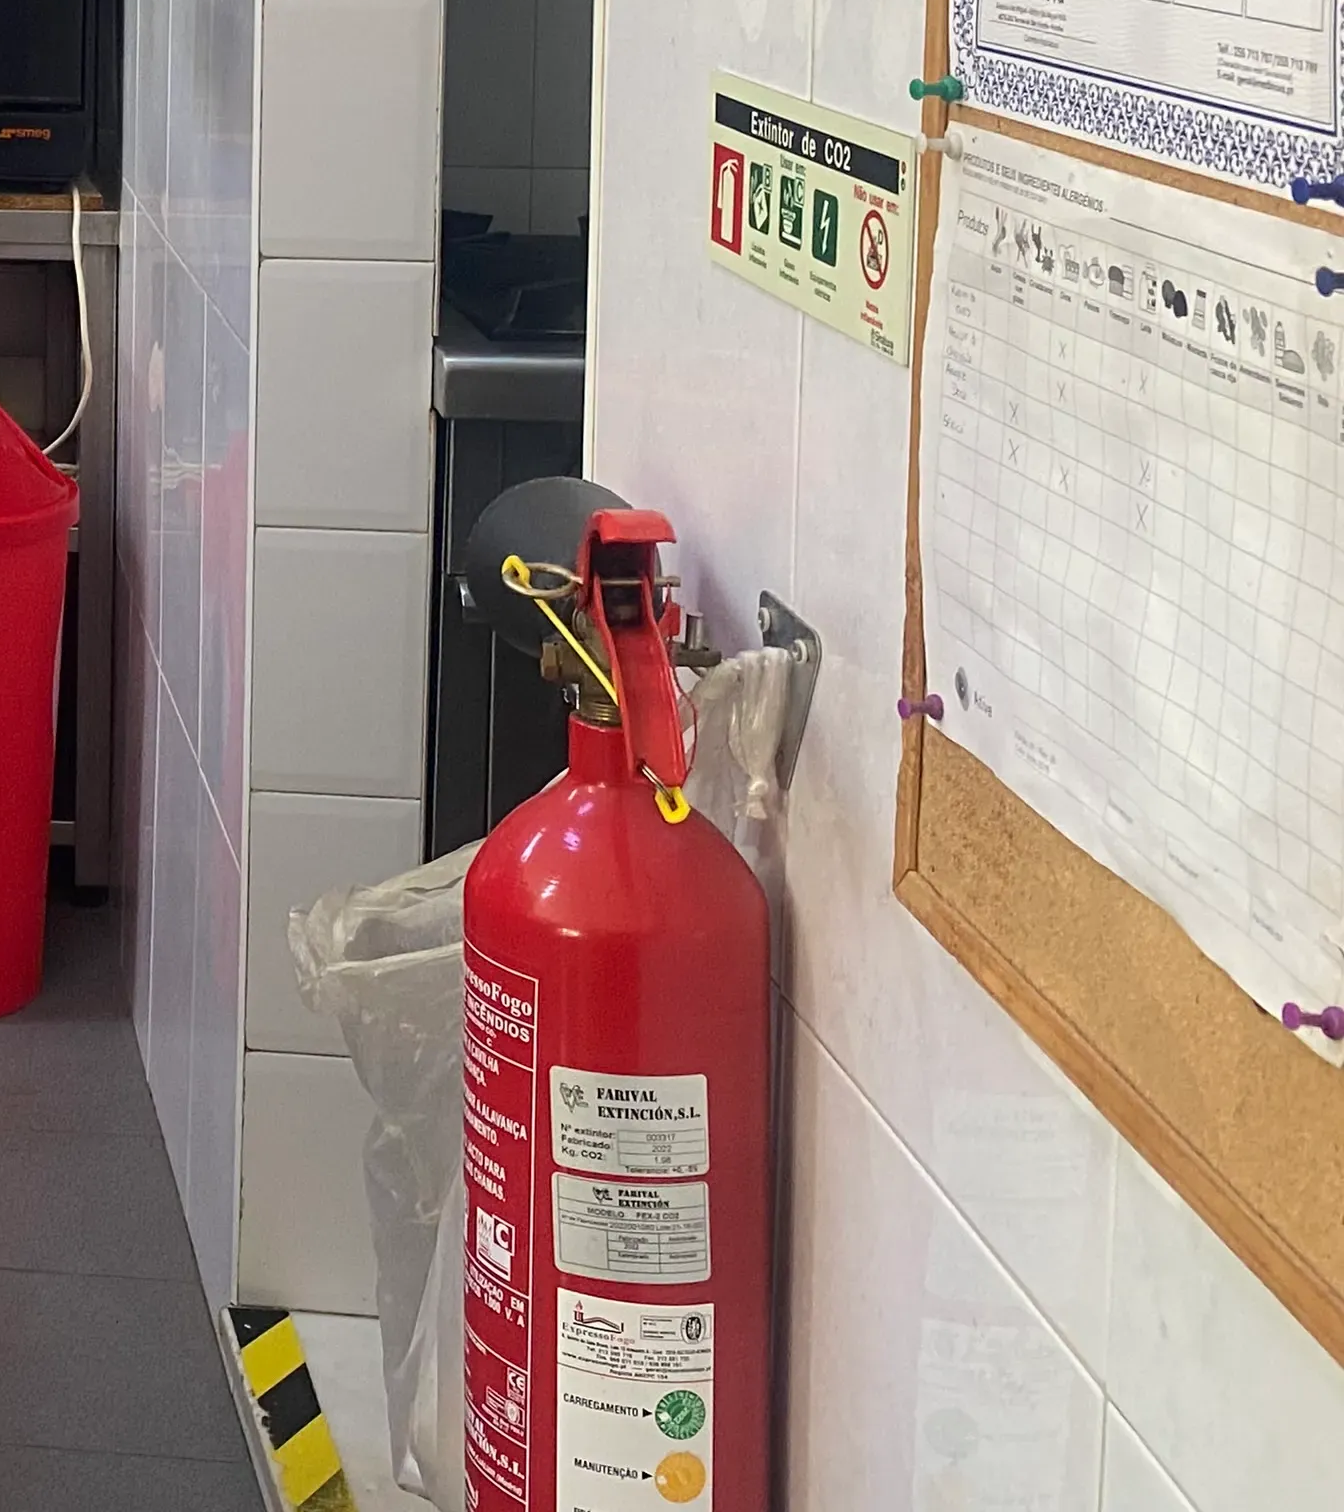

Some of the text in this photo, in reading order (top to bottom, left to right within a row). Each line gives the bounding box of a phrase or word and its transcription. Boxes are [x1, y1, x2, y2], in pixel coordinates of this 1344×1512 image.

[16, 128, 51, 141] smeg
[751, 110, 852, 172] Extintor de CO2
[780, 154, 794, 171] Usar
[962, 150, 995, 174] PRODUTOS
[1017, 169, 1062, 198] INGREDIENTES
[854, 183, 868, 202] Não
[869, 192, 884, 209] usar
[958, 208, 990, 236] Produtos
[596, 1087, 658, 1103] FARIVAL
[597, 1106, 701, 1121] EXTINCIÓN,S.L.
[574, 1126, 616, 1139] extintor:
[618, 1189, 660, 1199] FARIVAL
[587, 1207, 625, 1218] MODELO
[618, 1200, 670, 1209] EXTINCIÓN
[563, 1392, 639, 1418] CARREGAMENTO
[574, 1457, 639, 1480] MANUTENÇÃO
